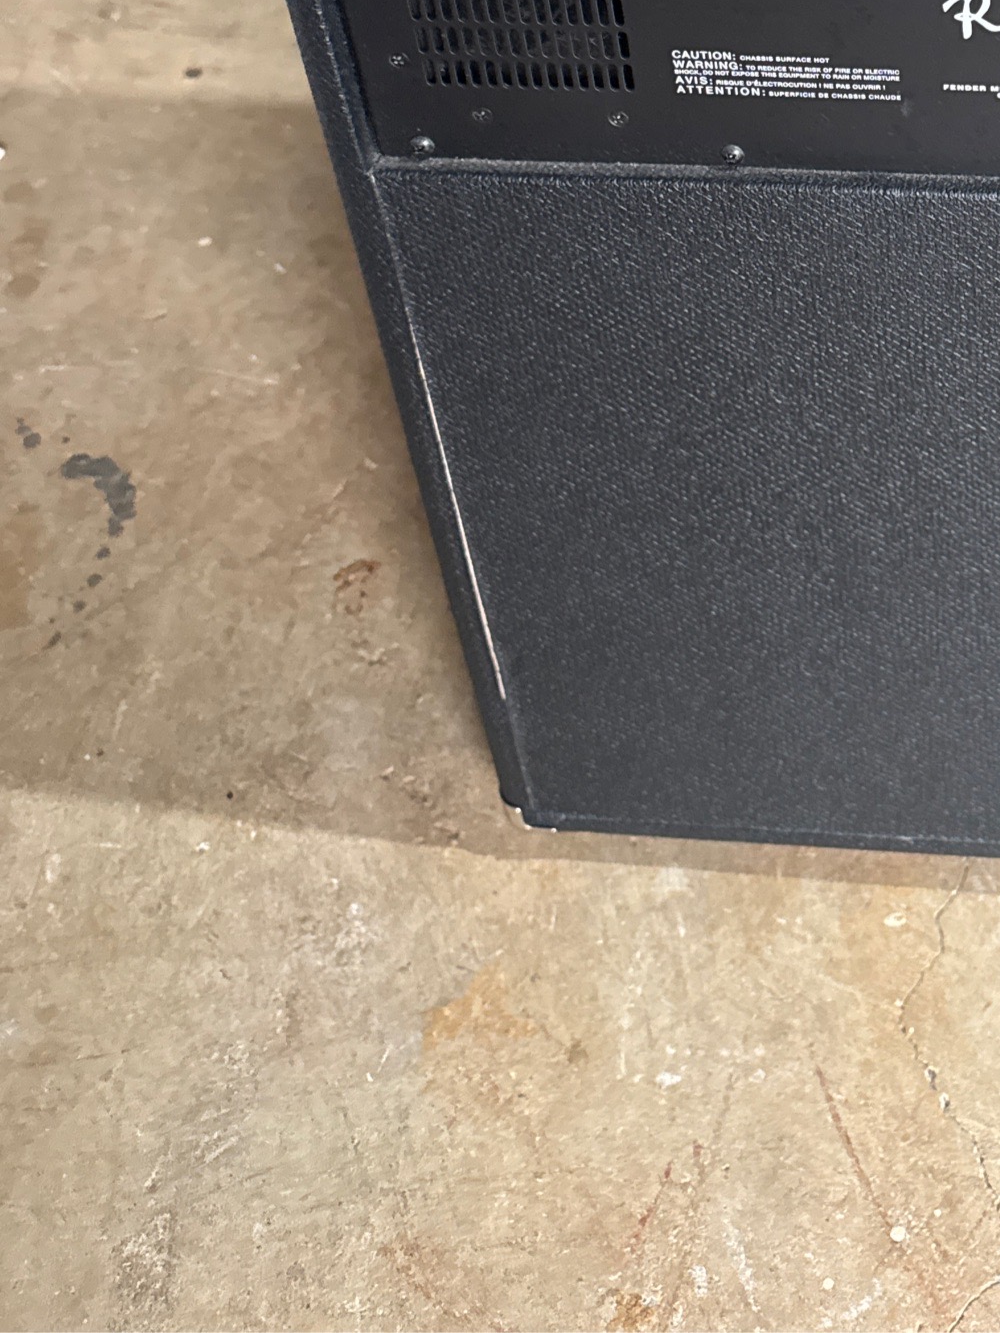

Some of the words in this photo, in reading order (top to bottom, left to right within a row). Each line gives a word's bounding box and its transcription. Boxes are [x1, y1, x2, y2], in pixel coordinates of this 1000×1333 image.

[671, 50, 736, 60] CAUTION:
[677, 85, 766, 96] ATTENTION:
[831, 92, 866, 100] CHASSIS
[868, 93, 902, 101] CHAUDE
[943, 84, 987, 92] FENDER
